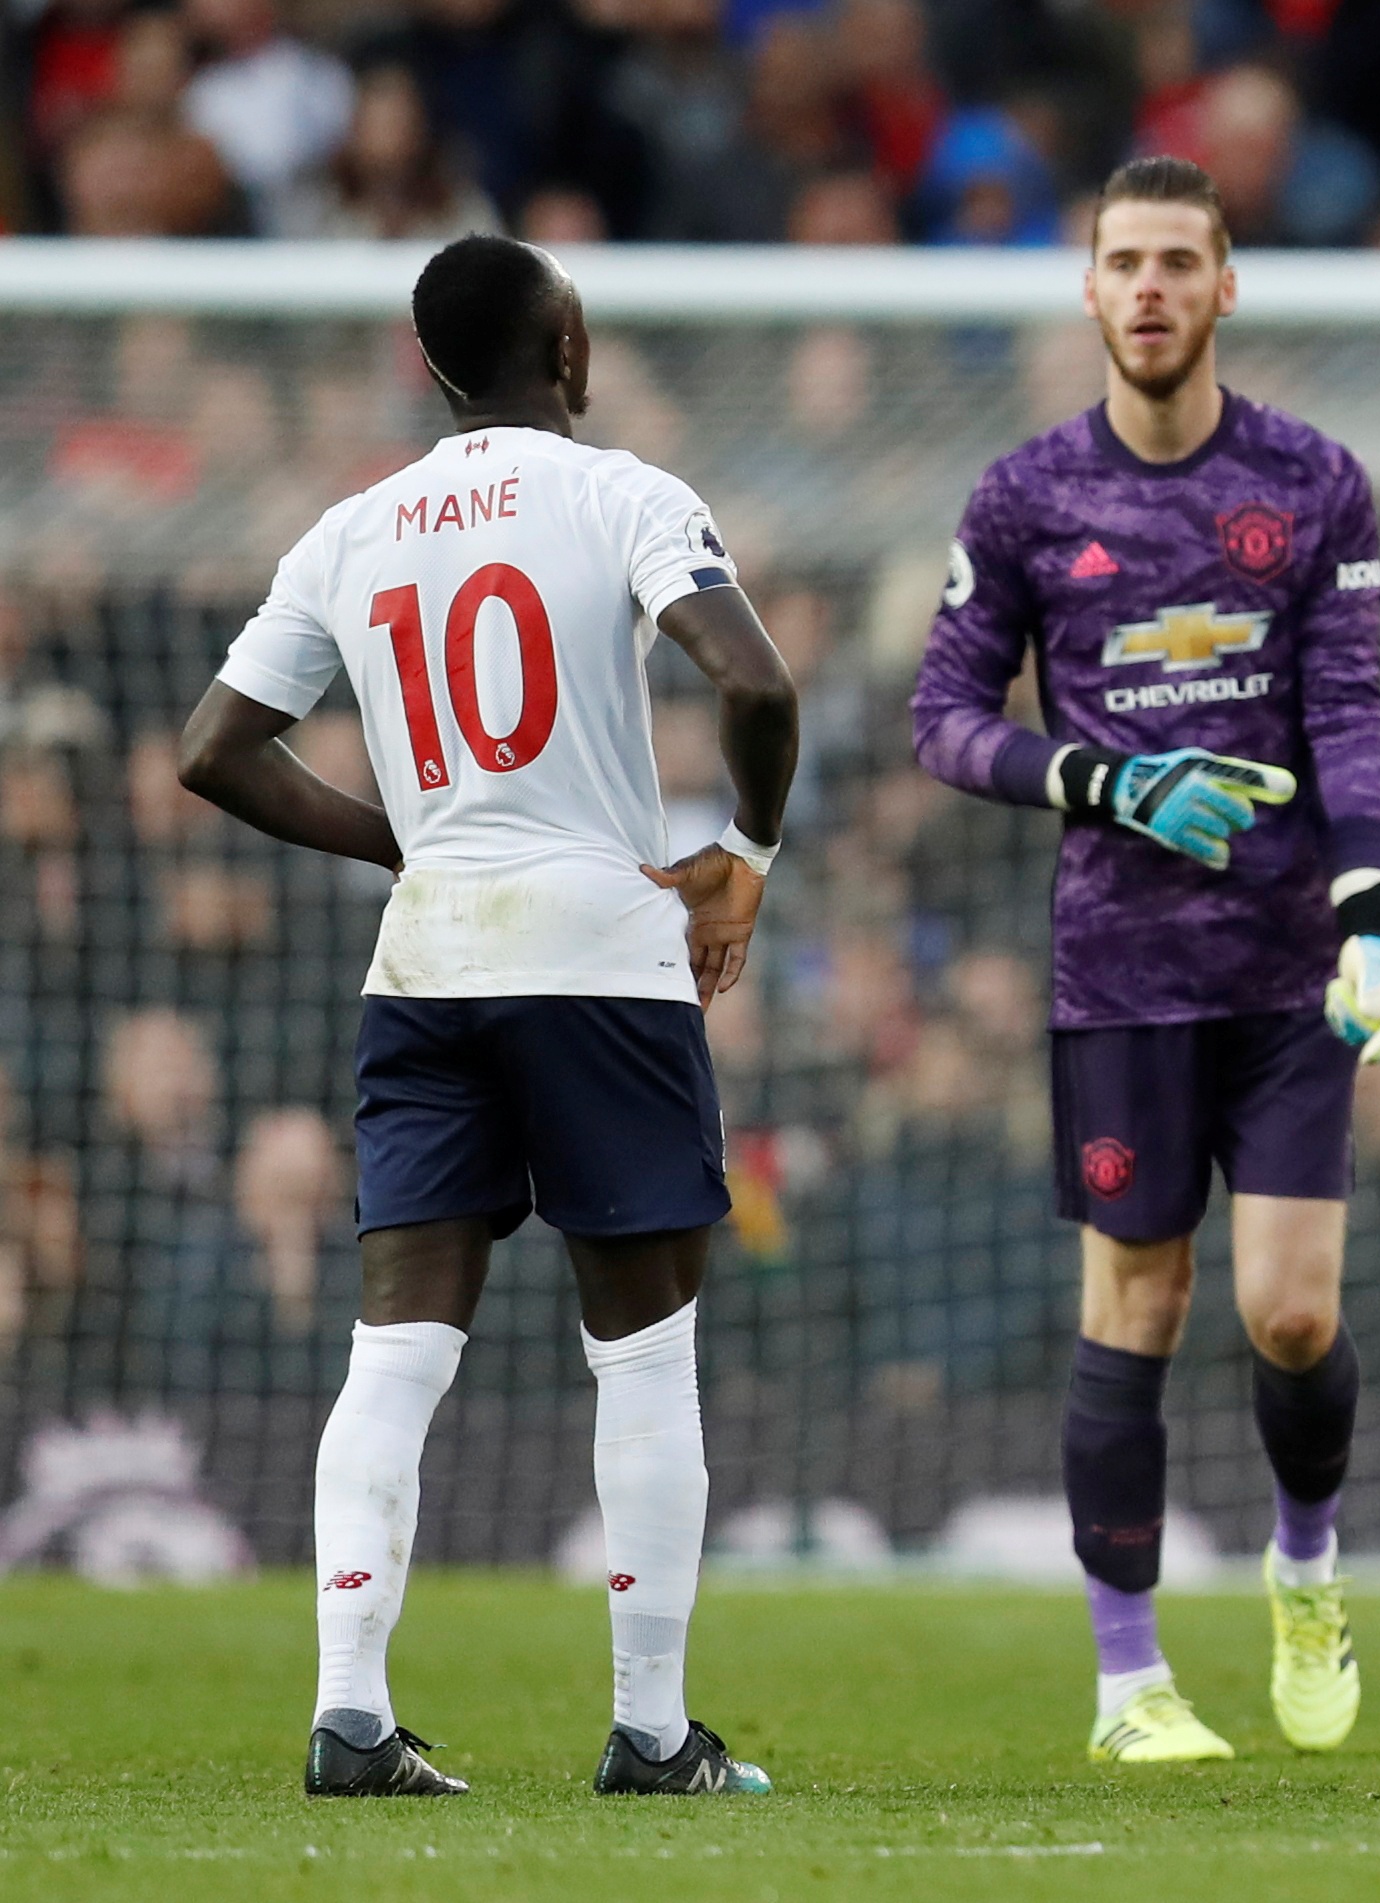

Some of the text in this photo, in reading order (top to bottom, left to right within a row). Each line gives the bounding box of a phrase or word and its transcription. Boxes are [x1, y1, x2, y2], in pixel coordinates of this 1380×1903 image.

[396, 466, 519, 541] MANÉ
[368, 561, 559, 792] 10
[1104, 672, 1275, 713] CHEVROLET
